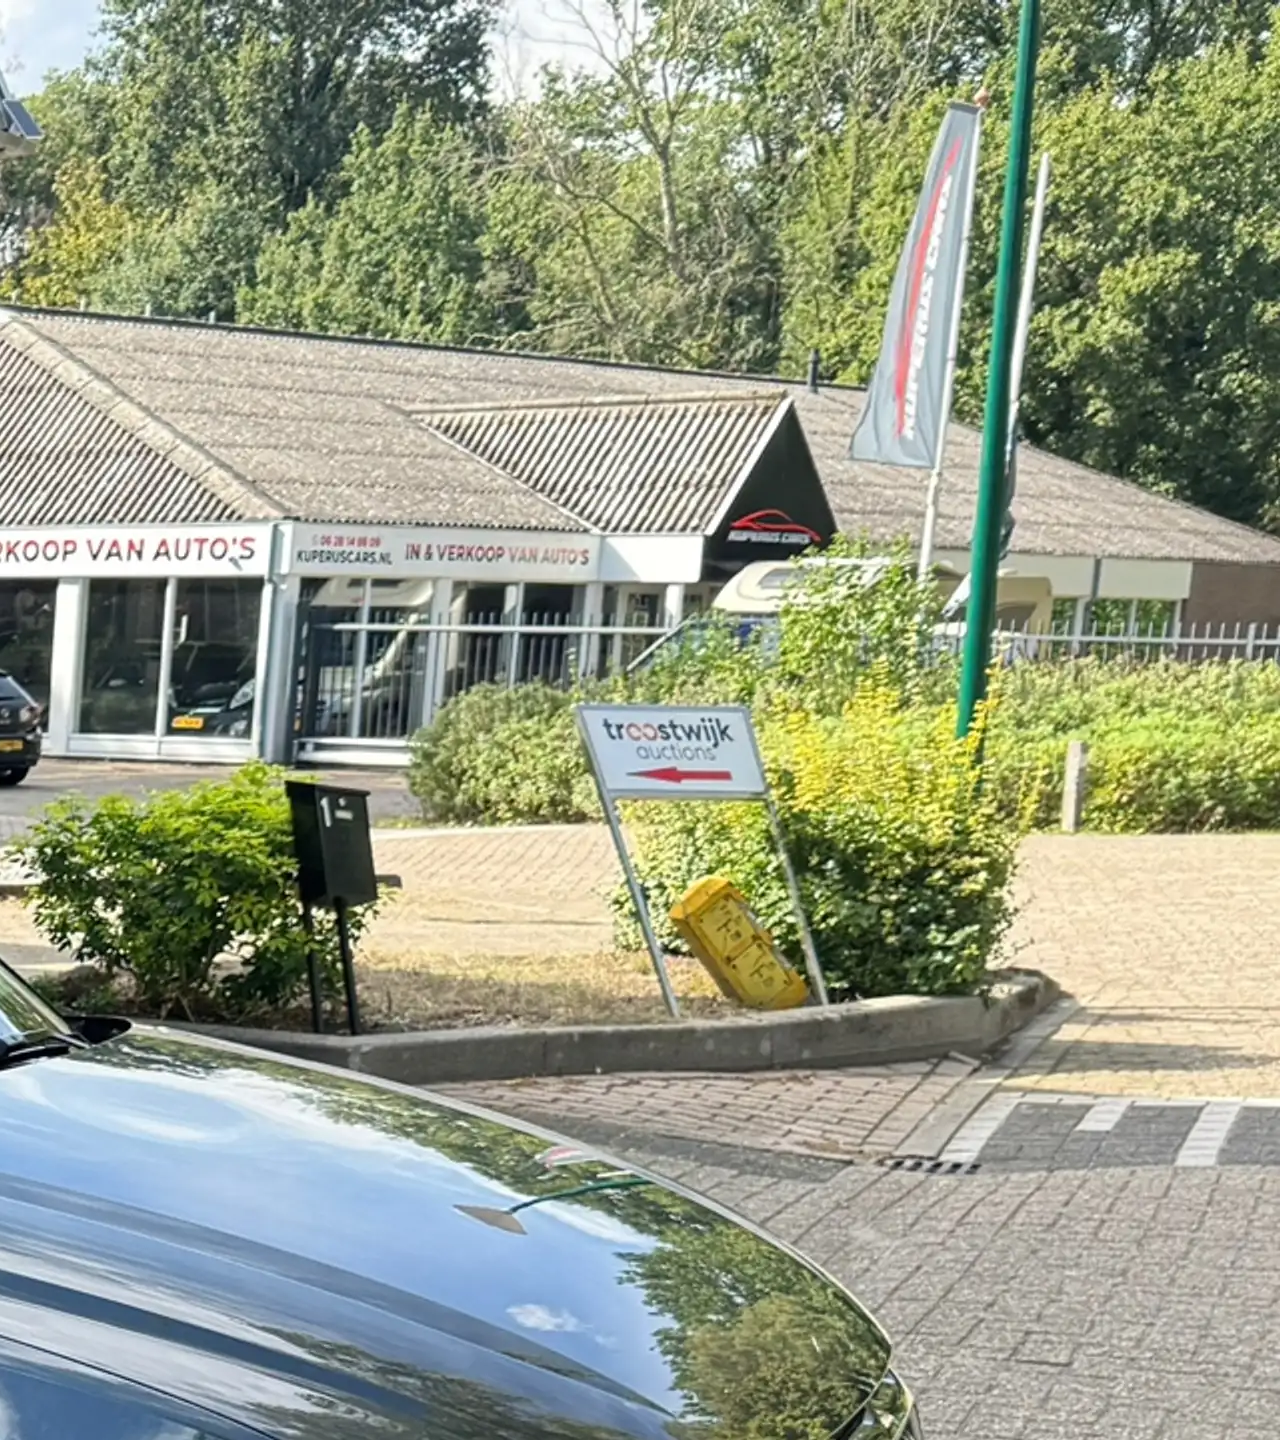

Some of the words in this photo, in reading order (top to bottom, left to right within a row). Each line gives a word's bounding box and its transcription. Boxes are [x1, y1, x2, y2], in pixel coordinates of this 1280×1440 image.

[86, 538, 145, 562] VAN
[152, 537, 257, 562] AUTO'S
[297, 550, 393, 565] KUPERUSCARS.NL
[405, 543, 421, 561] IN
[424, 544, 434, 562] &
[435, 543, 505, 563] VERKOOP
[508, 546, 538, 564] VAN
[540, 547, 590, 566] AUTO'S
[602, 717, 735, 748] troostwijk
[636, 743, 716, 761] auctions
